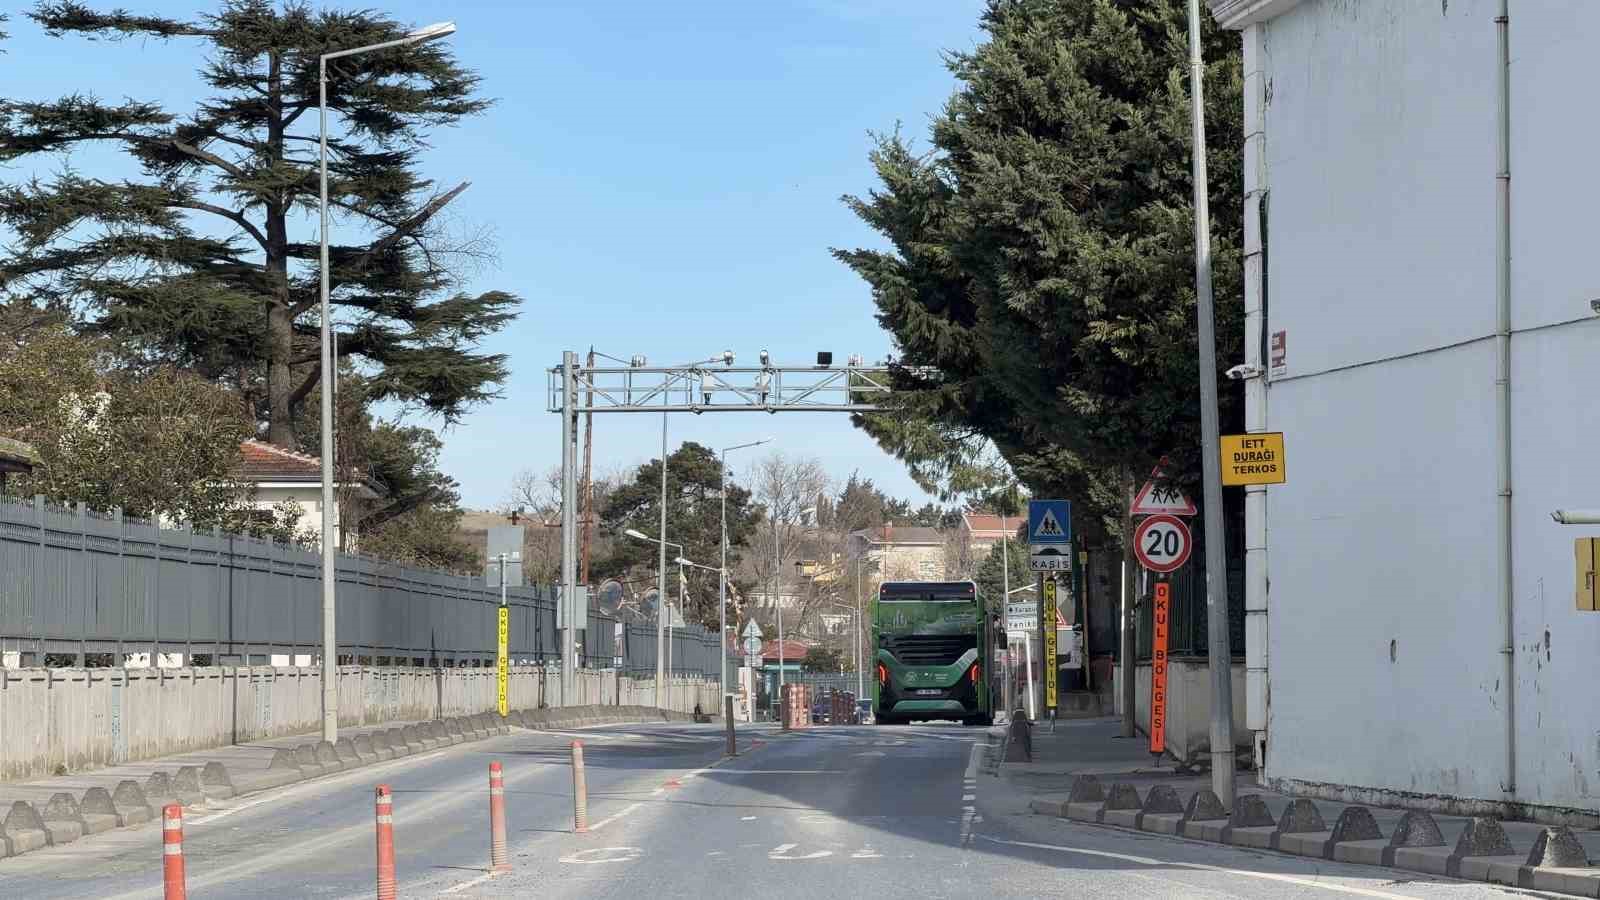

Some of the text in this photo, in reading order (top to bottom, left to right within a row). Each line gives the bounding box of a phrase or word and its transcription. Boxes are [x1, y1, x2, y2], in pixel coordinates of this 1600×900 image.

[1241, 437, 1266, 449] İETT
[1233, 448, 1275, 463] DURAĞI
[1232, 463, 1277, 475] TERKOS
[1147, 529, 1180, 557] 20
[1046, 583, 1055, 621] OKUL
[1156, 586, 1166, 638] OKUL
